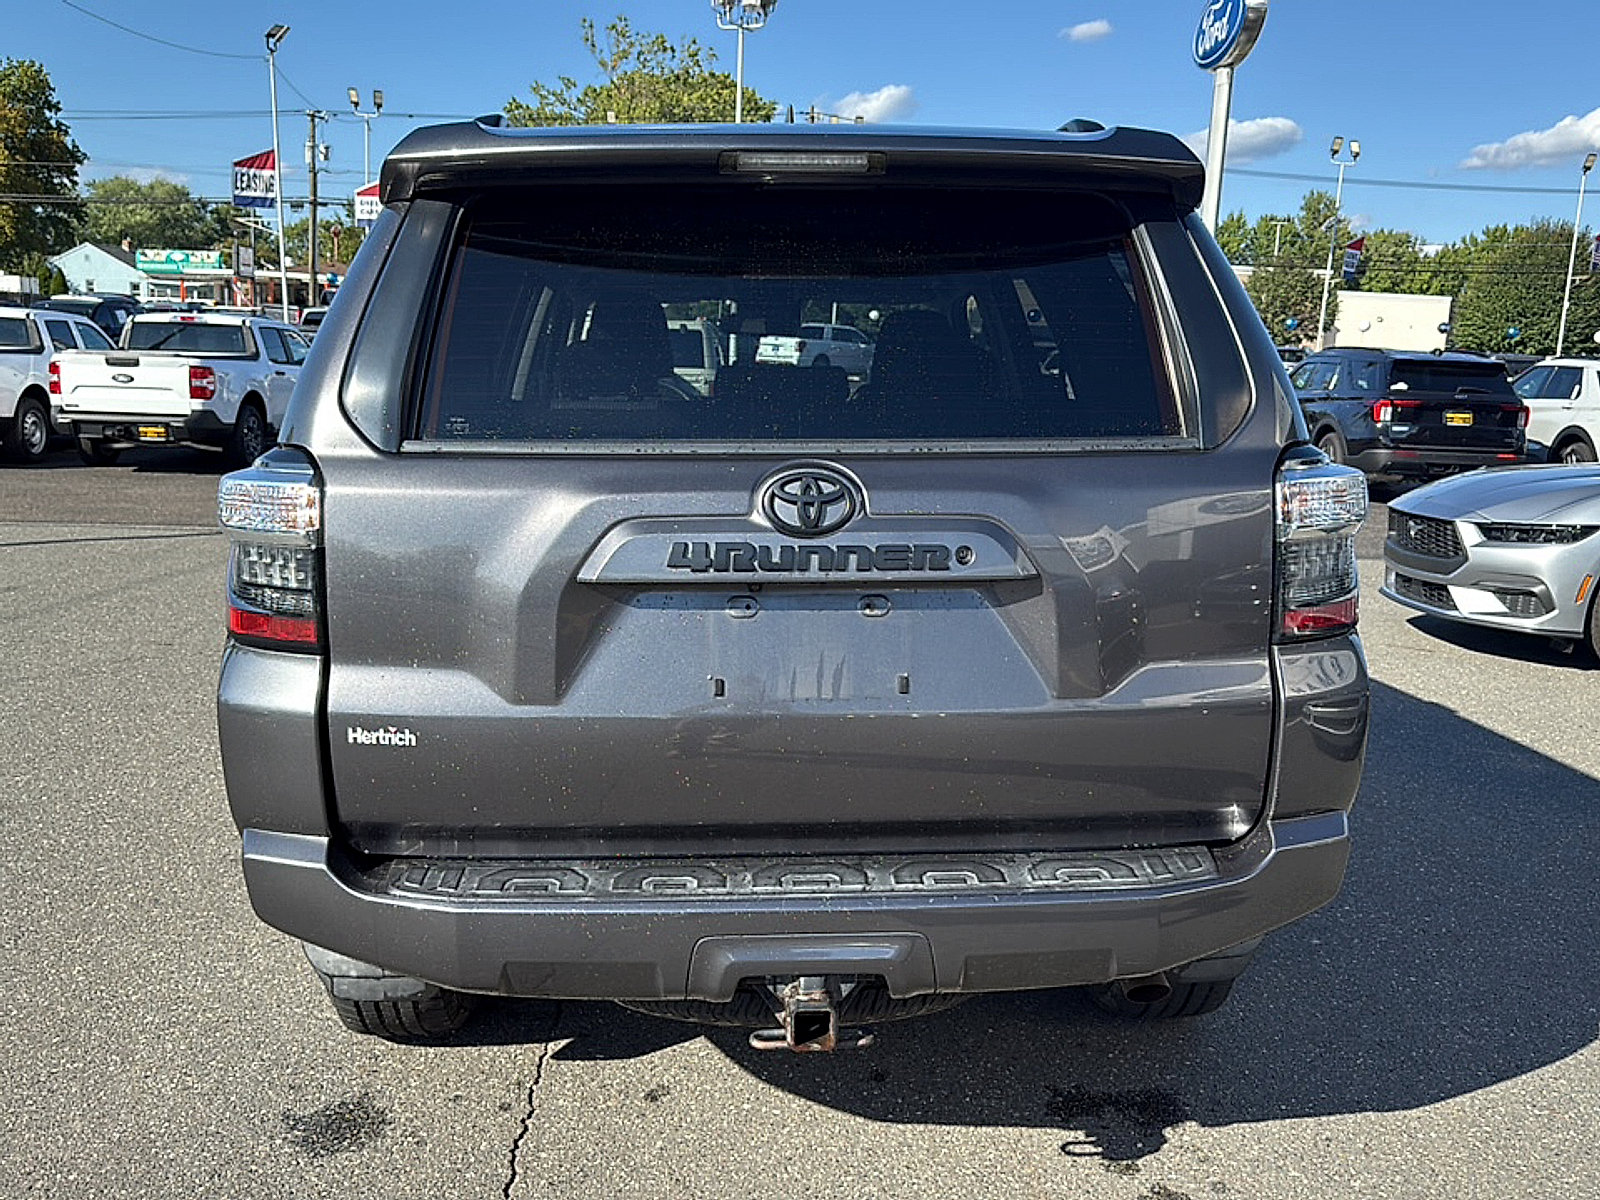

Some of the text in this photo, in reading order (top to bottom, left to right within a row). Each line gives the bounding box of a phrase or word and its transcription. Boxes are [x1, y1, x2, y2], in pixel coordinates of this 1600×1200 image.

[1198, 0, 1232, 57] Ford
[234, 171, 275, 194] LEASING
[347, 725, 417, 747] Hertrich
